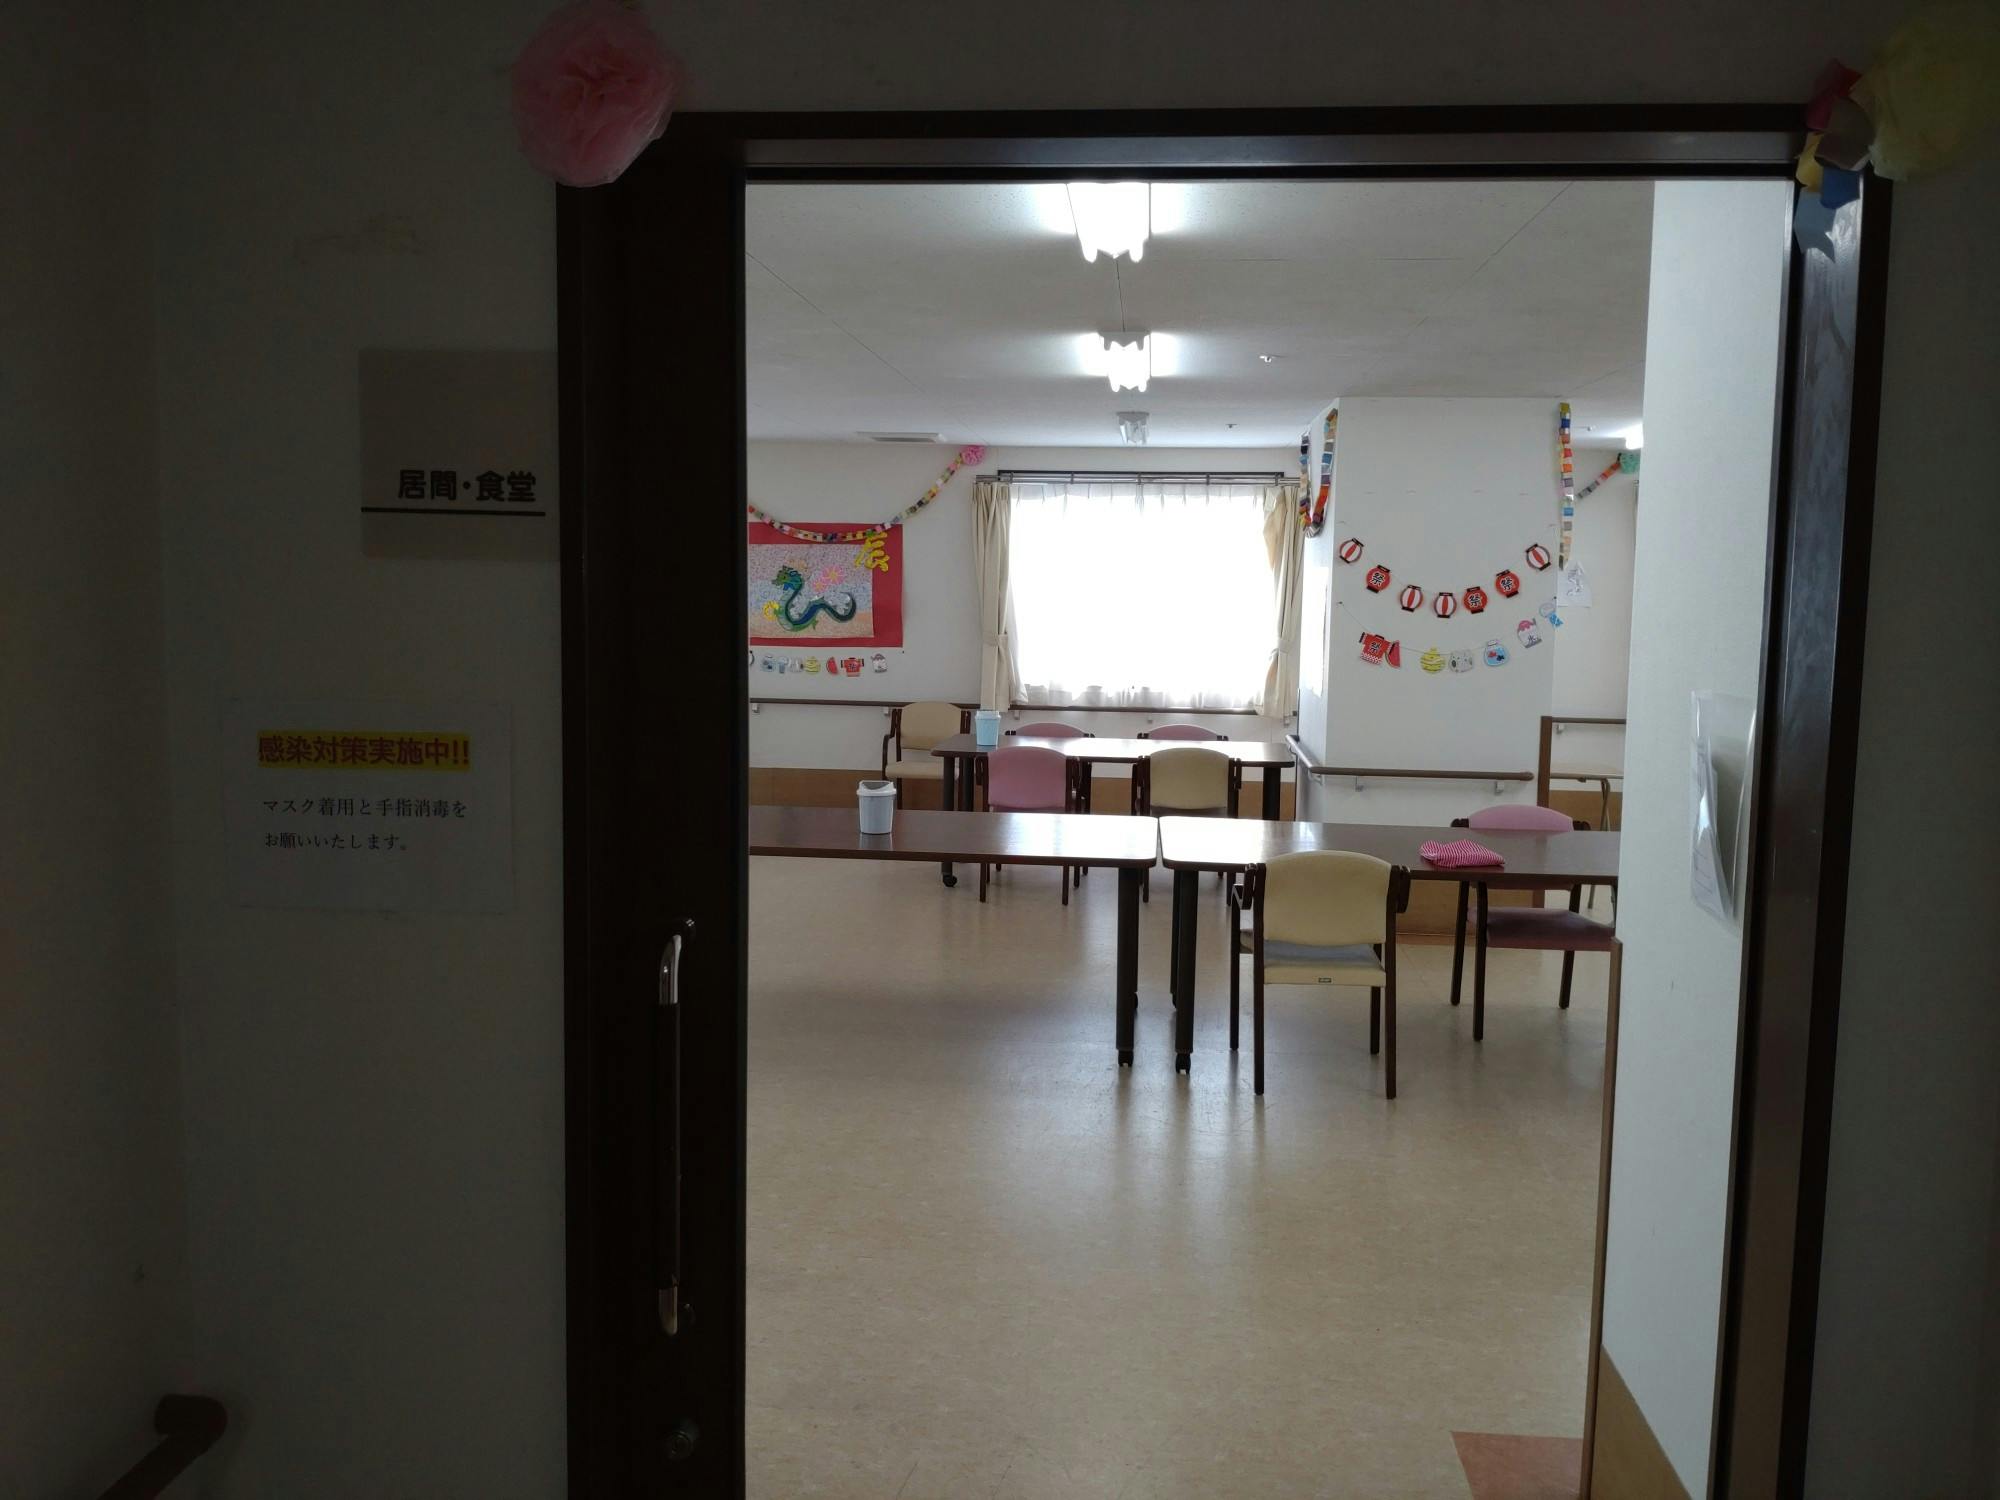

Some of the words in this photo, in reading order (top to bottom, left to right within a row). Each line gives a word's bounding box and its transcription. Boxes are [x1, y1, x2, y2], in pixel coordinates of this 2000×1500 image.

[398, 469, 537, 502] 居間・食堂
[1371, 572, 1385, 587] 祭
[1501, 577, 1514, 591] 祭
[1468, 593, 1482, 607] 祭
[263, 797, 467, 818] マスク着用と手指消毒を
[265, 831, 408, 851] お願いいたします。
